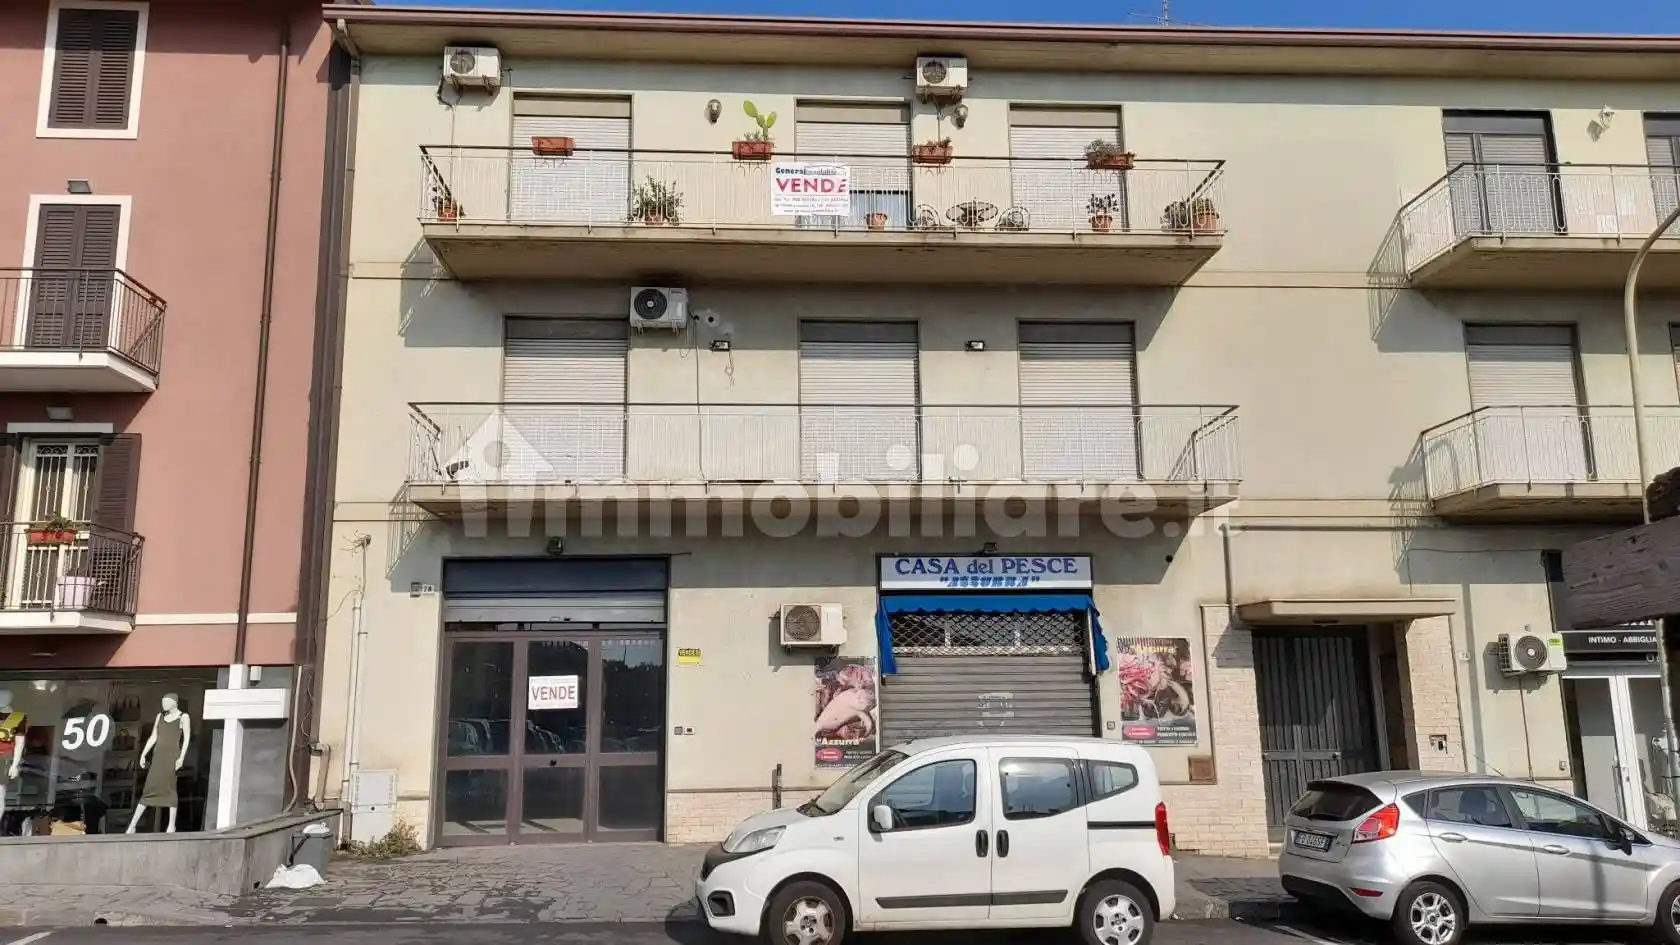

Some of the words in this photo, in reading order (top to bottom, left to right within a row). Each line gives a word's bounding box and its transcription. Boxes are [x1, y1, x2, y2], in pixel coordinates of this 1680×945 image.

[895, 558, 960, 575] CASA
[966, 559, 994, 575] del
[1001, 558, 1078, 574] PESCE
[1588, 636, 1617, 644] INTIMO
[532, 685, 576, 701] VENDE
[62, 714, 110, 750] 50
